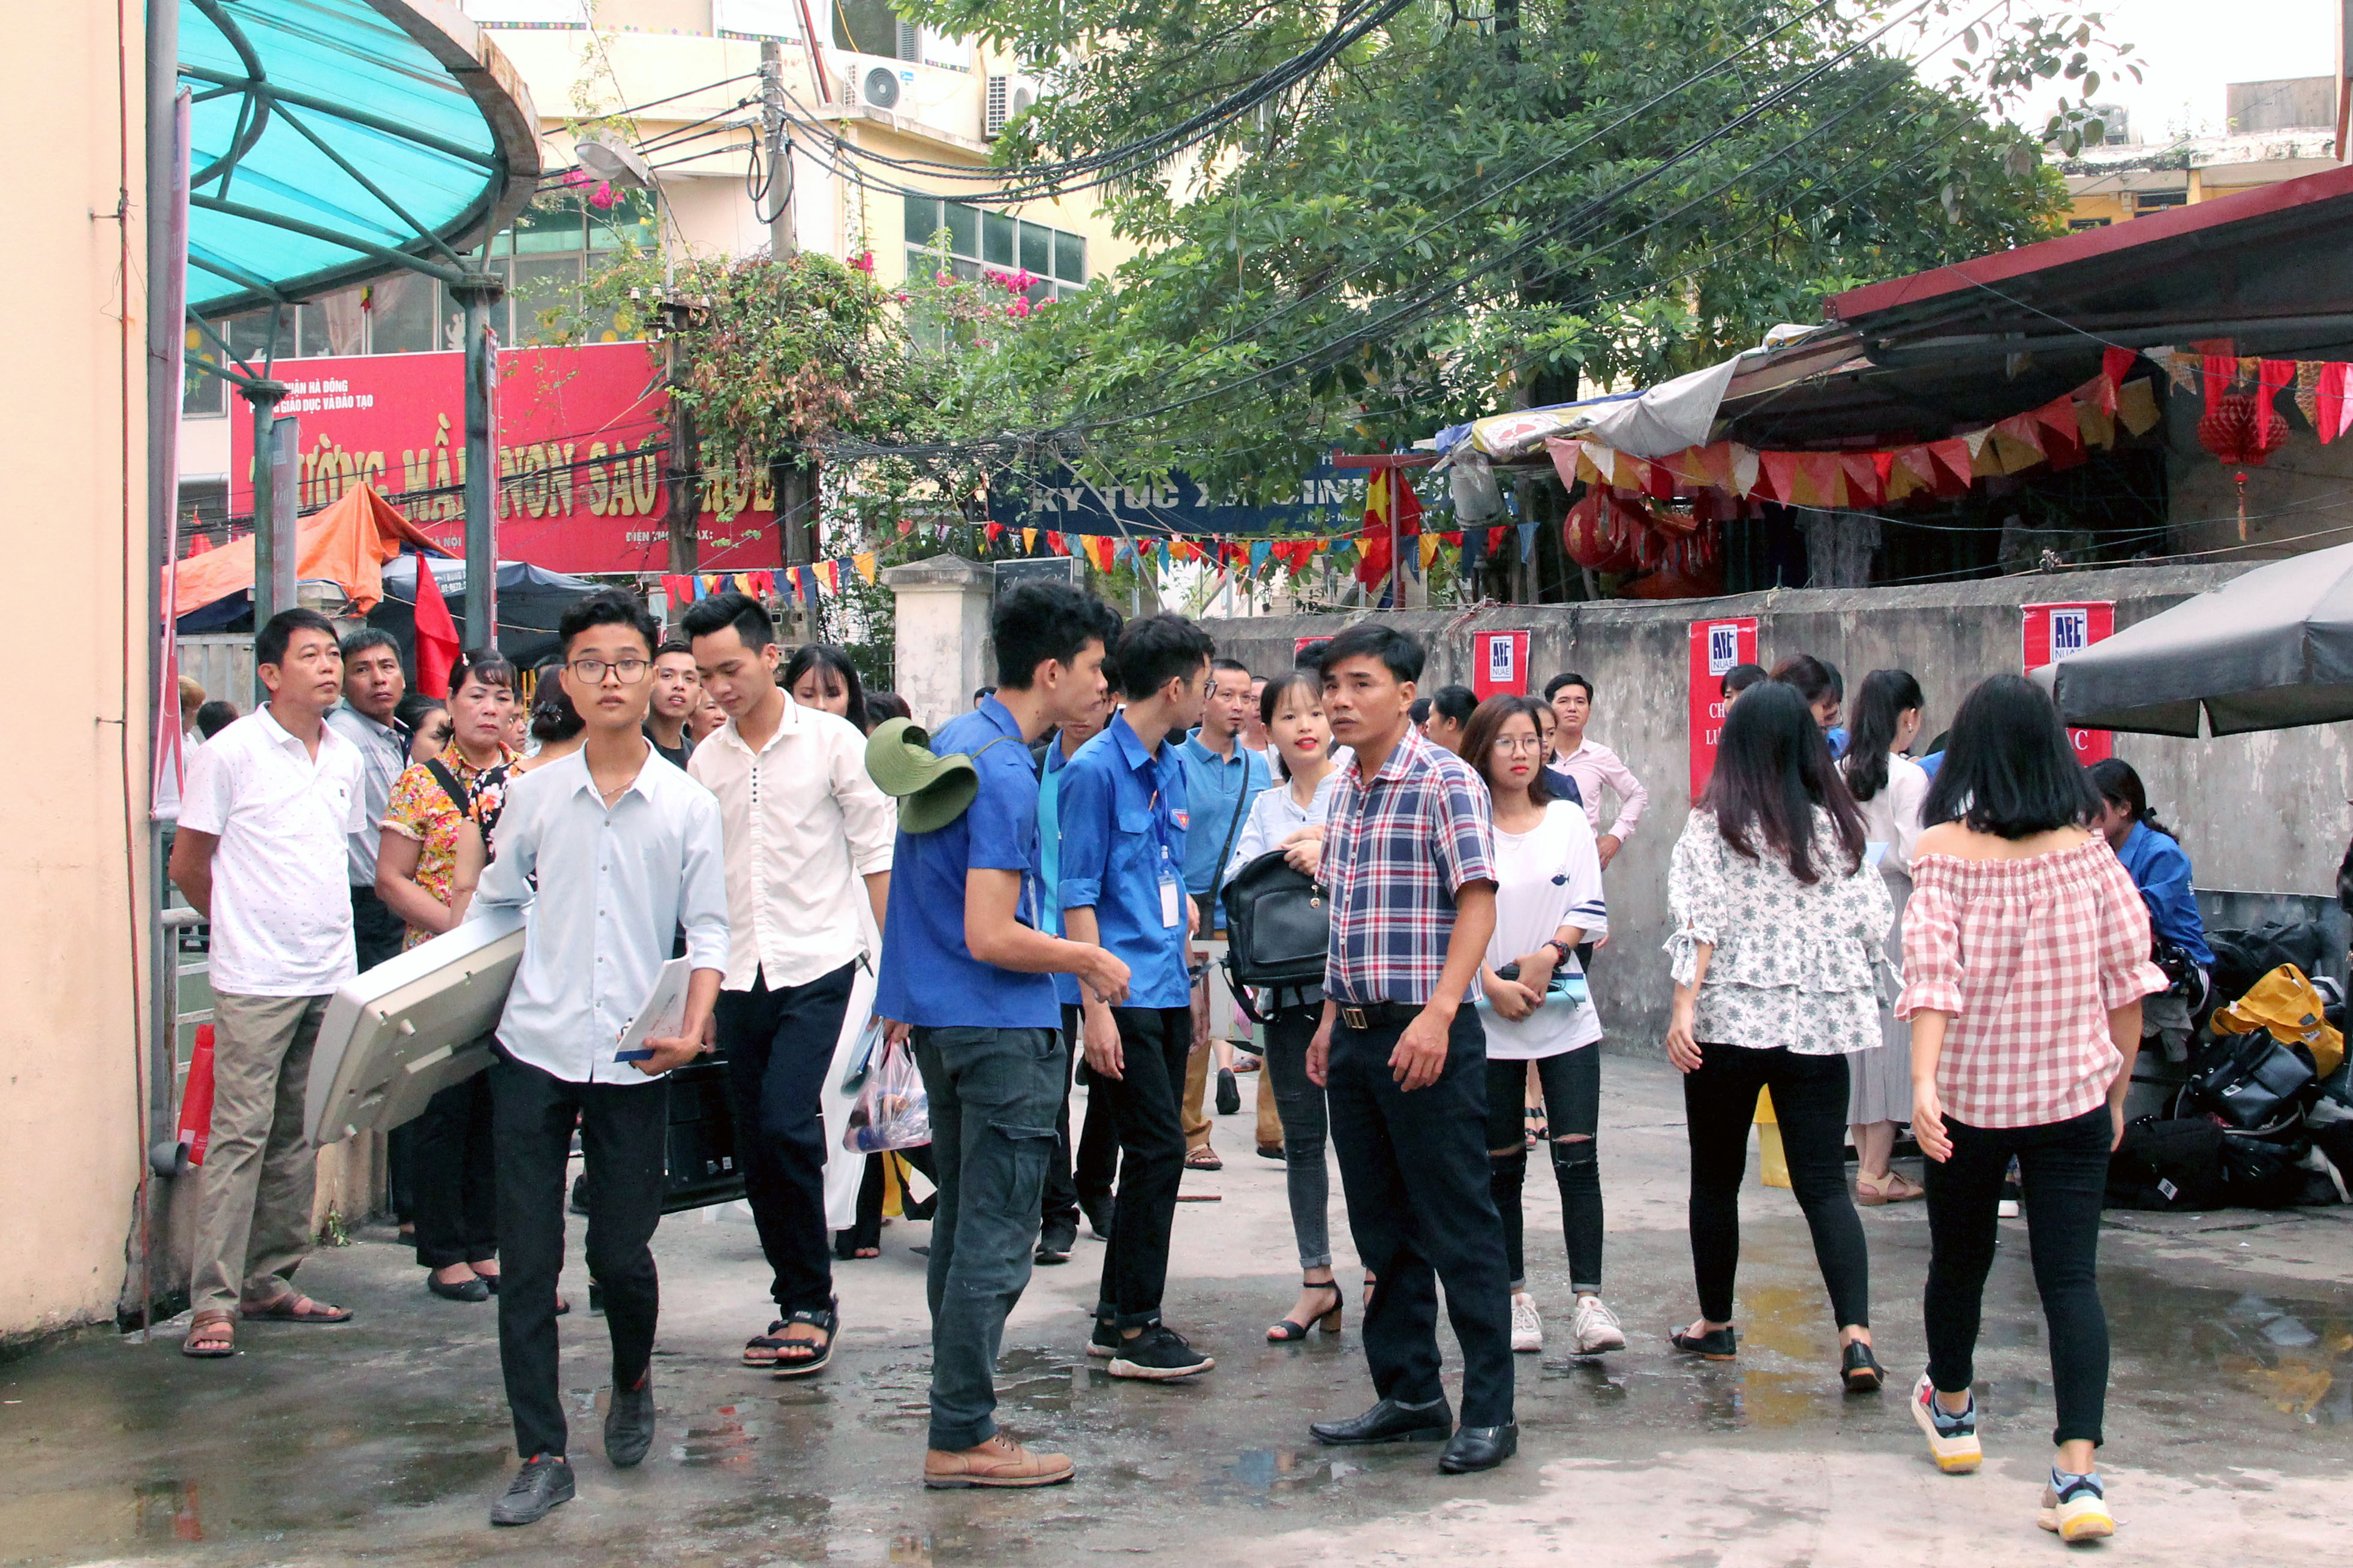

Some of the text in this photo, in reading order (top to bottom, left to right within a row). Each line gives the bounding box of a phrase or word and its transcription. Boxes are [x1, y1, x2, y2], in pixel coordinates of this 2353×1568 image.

[309, 378, 321, 394] HÀ
[323, 377, 348, 393] ĐÔNG
[281, 396, 302, 413] GIÁO
[303, 398, 321, 414] DỤC
[323, 394, 335, 410] VÀ
[356, 394, 374, 410] TẠO
[499, 443, 575, 518] NON
[589, 441, 657, 516] SAO
